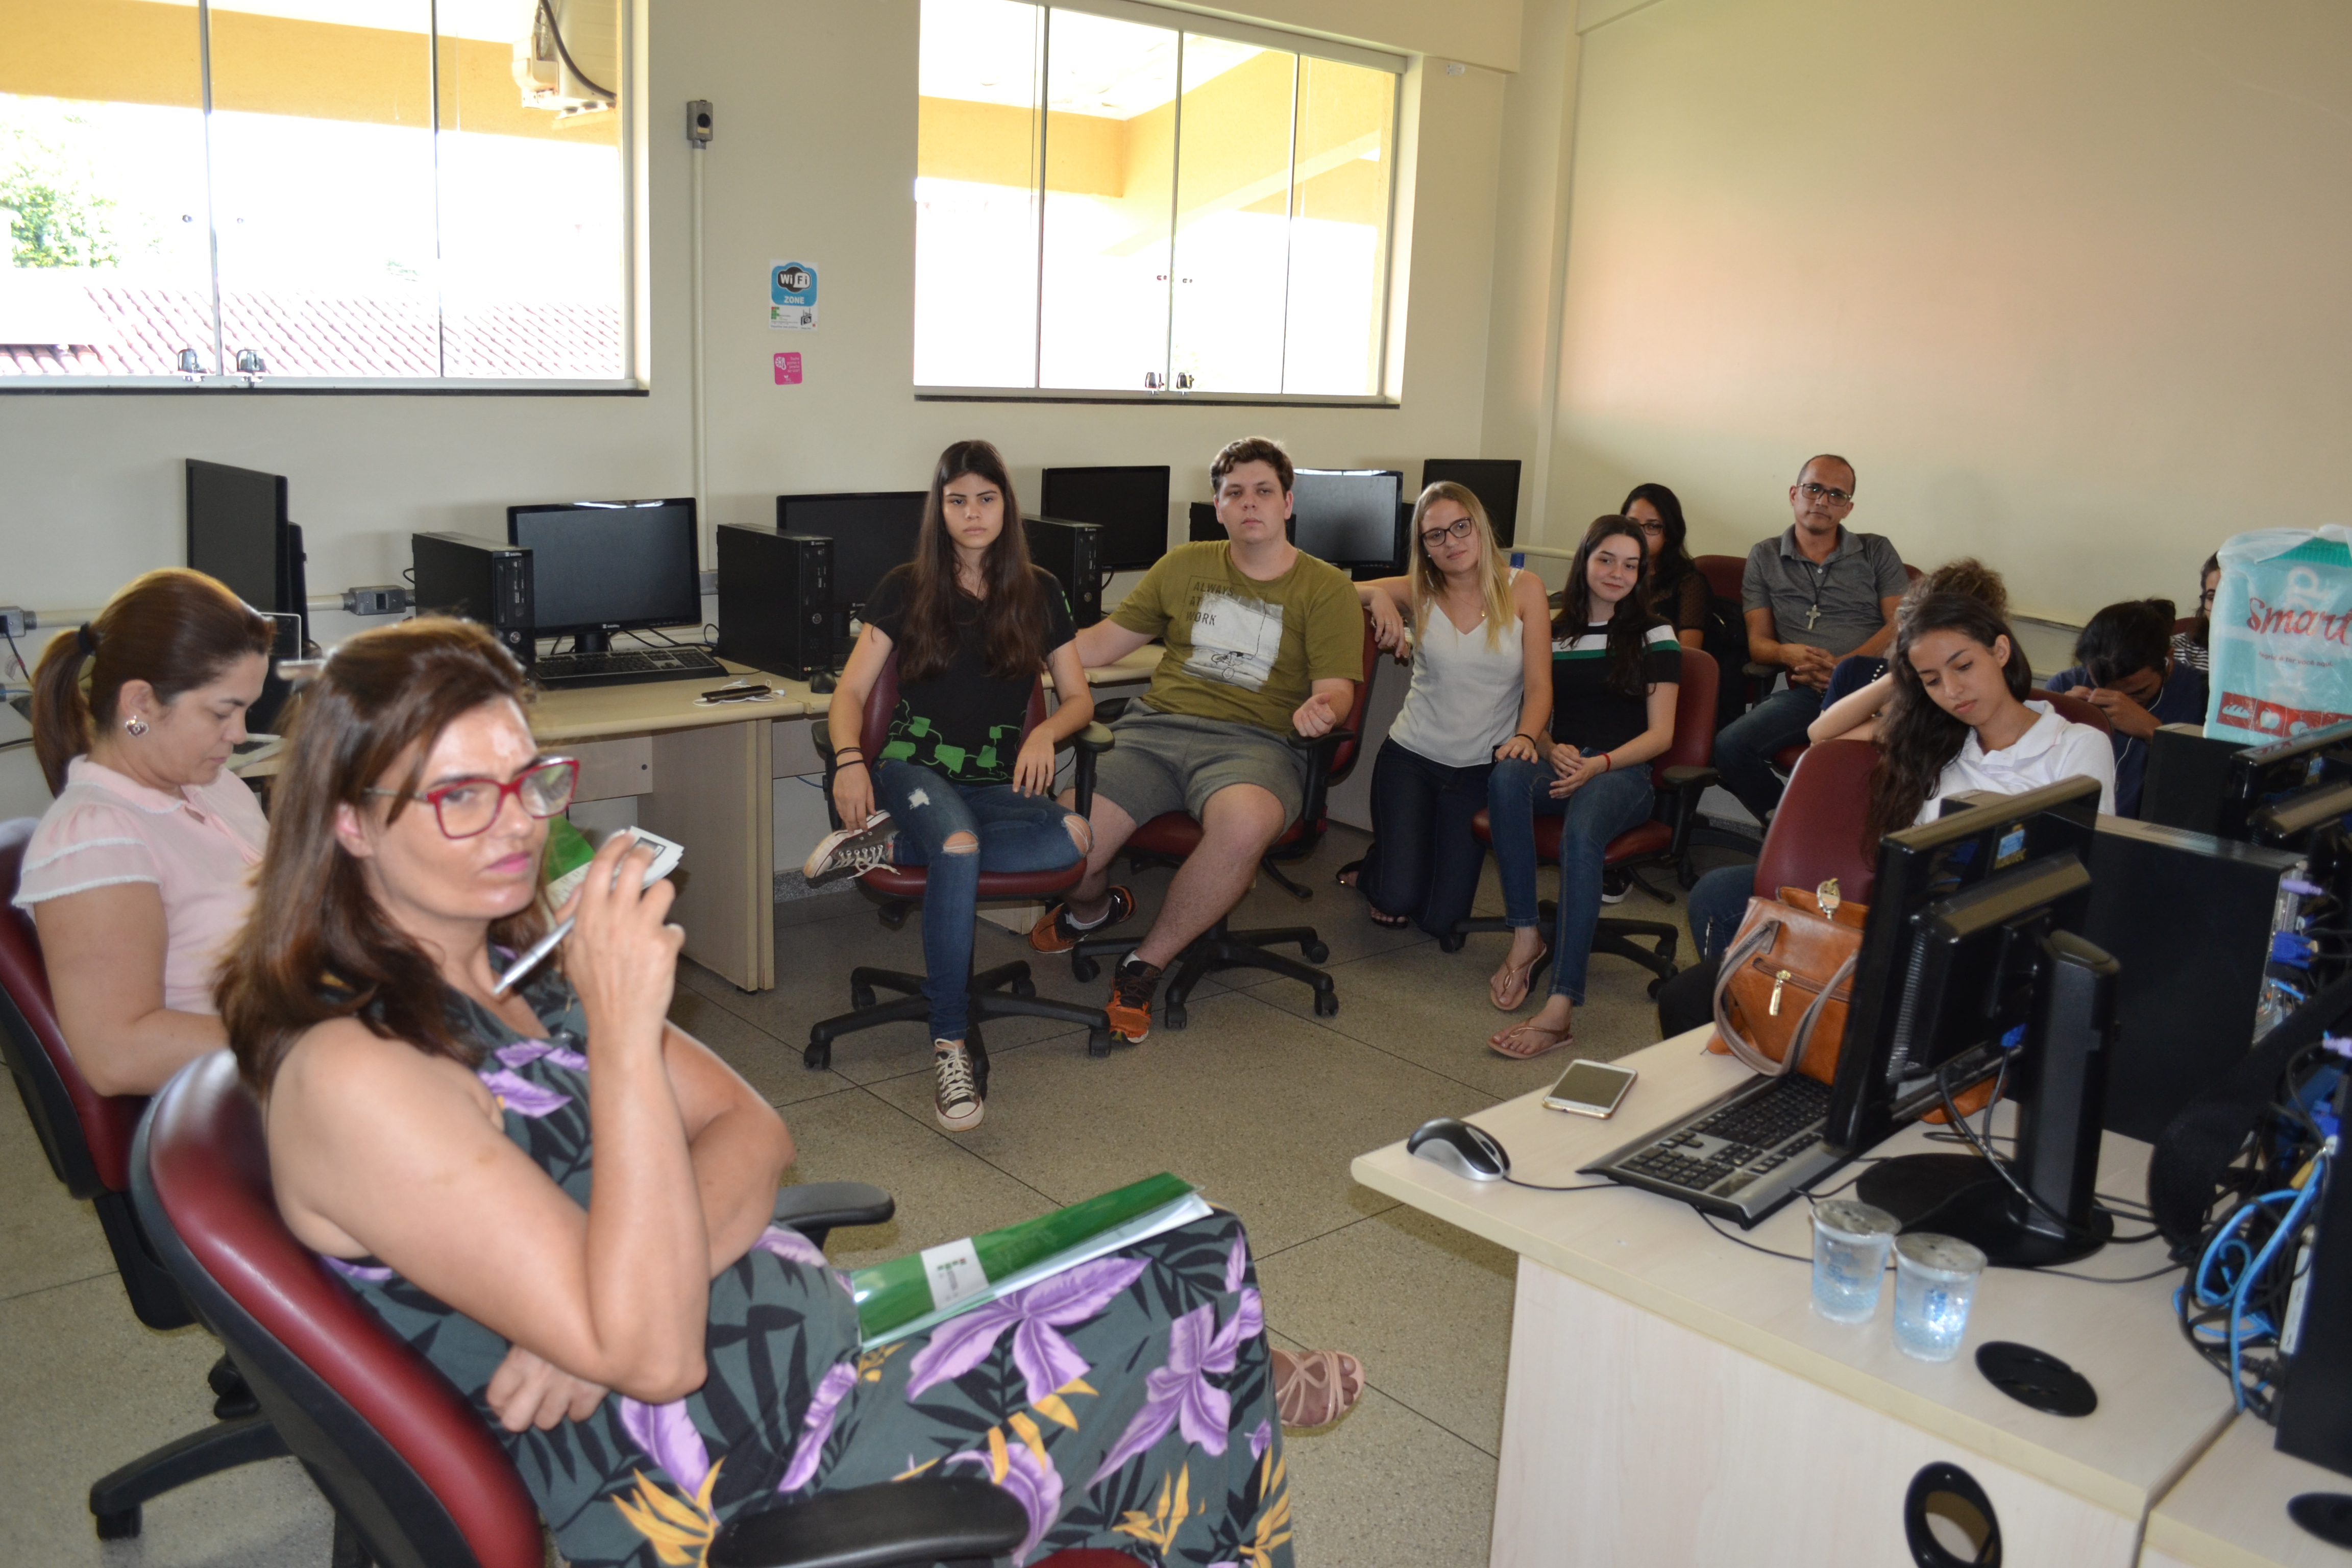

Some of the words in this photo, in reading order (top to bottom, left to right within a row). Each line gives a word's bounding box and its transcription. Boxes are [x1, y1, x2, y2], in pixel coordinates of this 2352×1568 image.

[783, 296, 805, 304] ZONE
[1193, 582, 1234, 596] ALWAYS
[1189, 596, 1203, 606] AT
[1186, 611, 1217, 626] WORK
[2247, 597, 2352, 646] Smart
